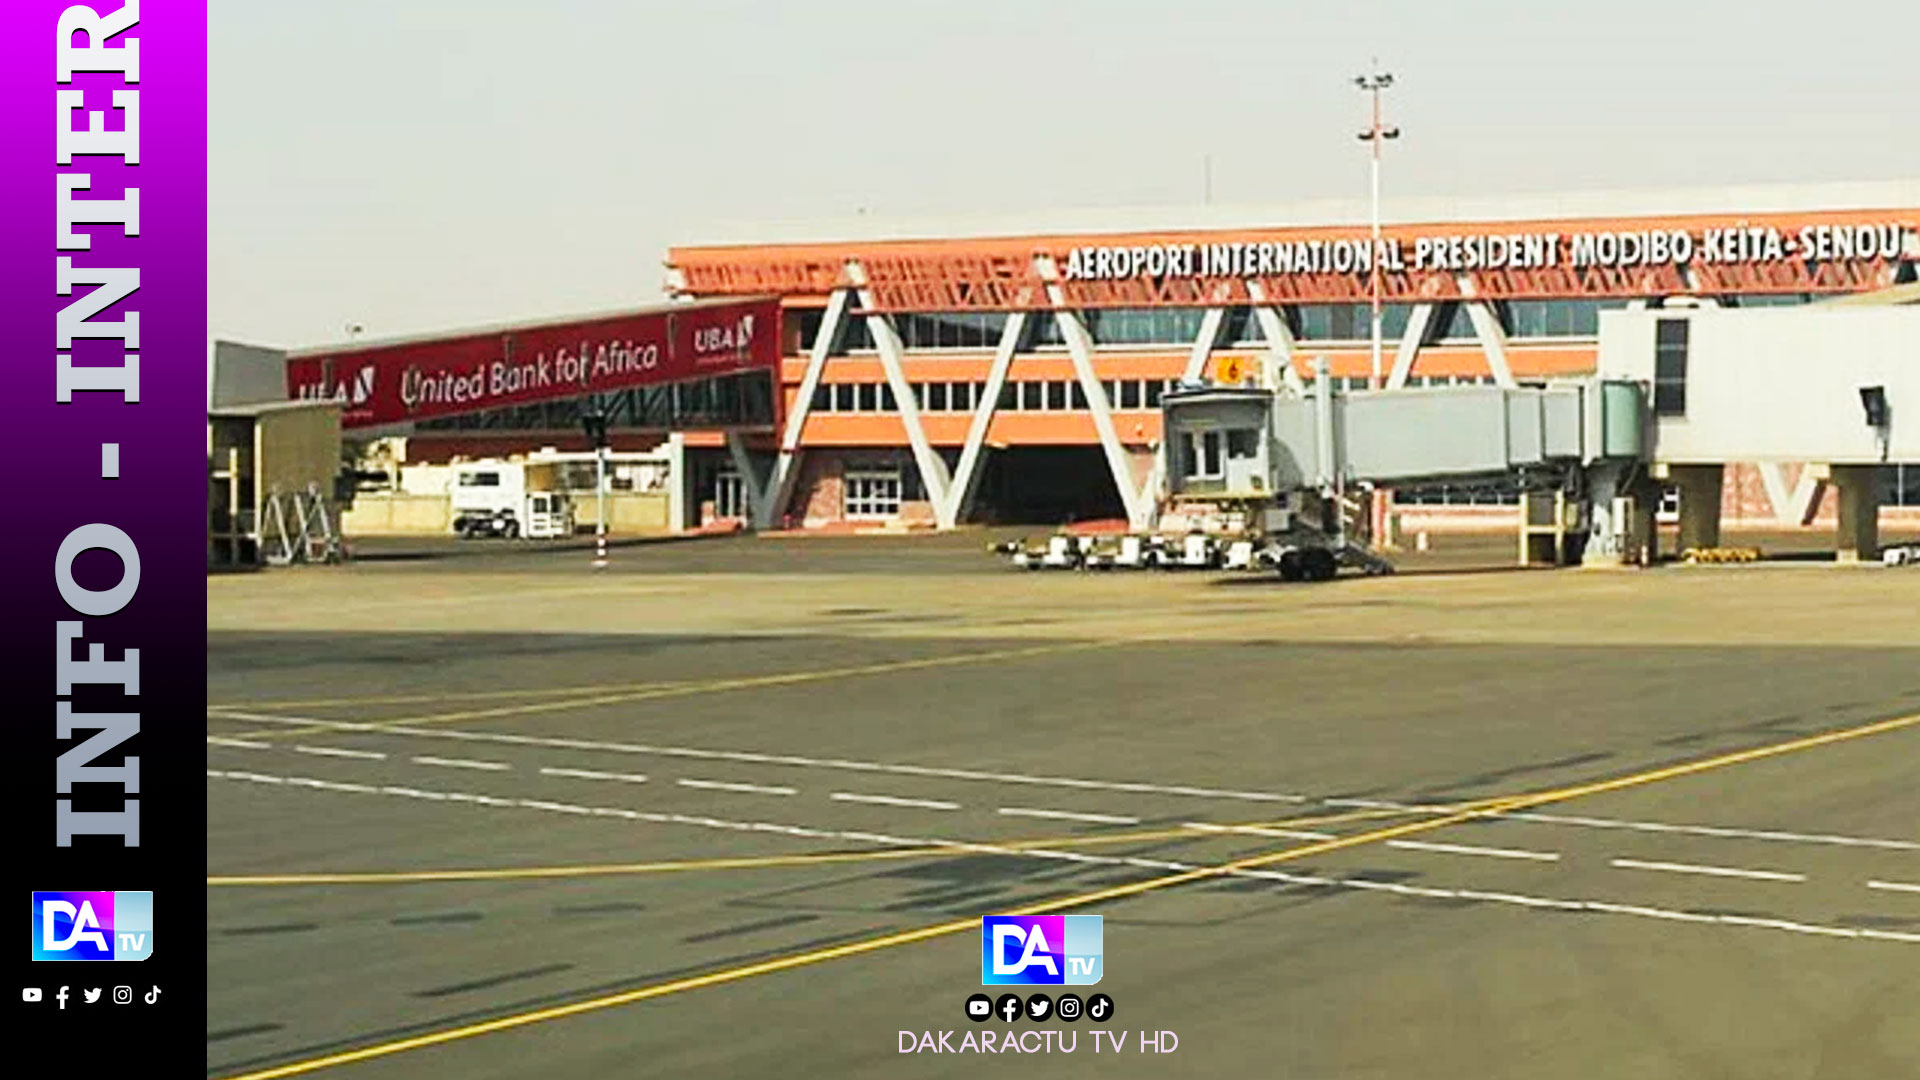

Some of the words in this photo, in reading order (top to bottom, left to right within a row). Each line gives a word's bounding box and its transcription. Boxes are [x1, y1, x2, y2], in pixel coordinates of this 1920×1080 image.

[1067, 244, 1195, 280] AEROPORT
[1201, 239, 1404, 277] INTERNATIONAL
[1416, 233, 1559, 270] PRESIDENT
[1571, 230, 1692, 268] MODIBO
[695, 327, 736, 352] UBA
[401, 364, 486, 407] United
[490, 352, 551, 396] Bank
[555, 343, 588, 384] for
[592, 340, 658, 378] Africa
